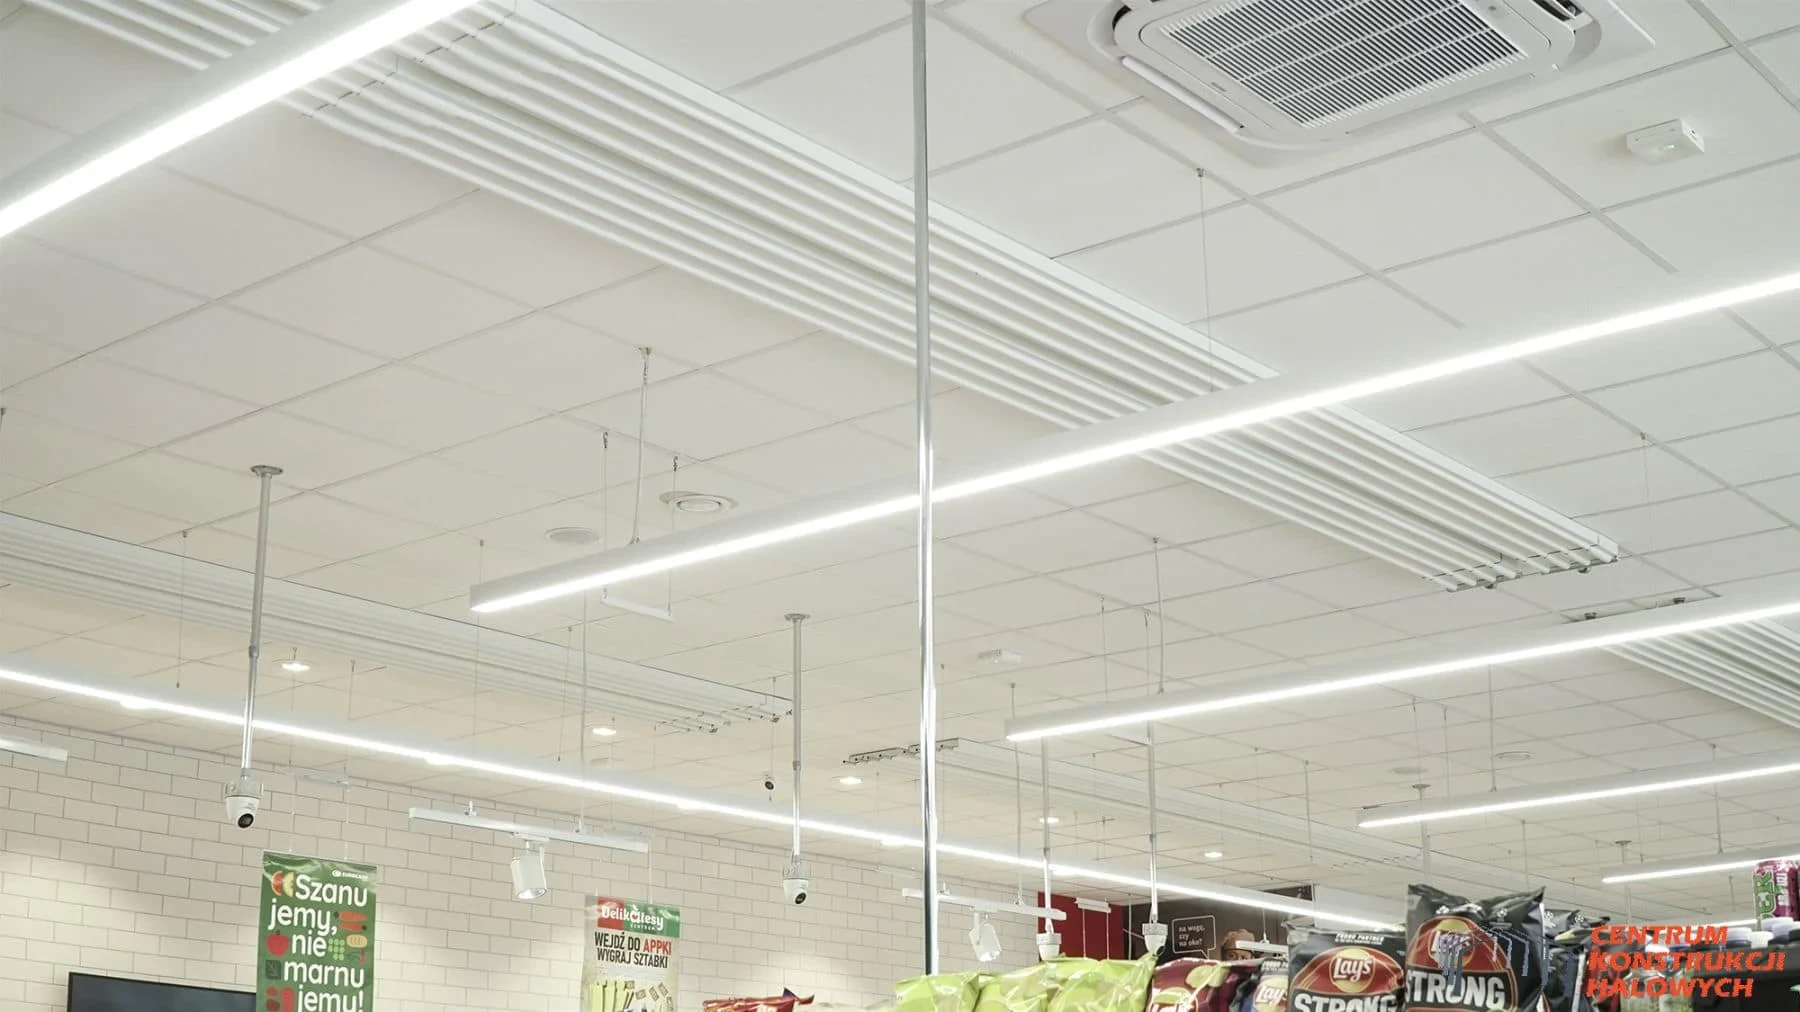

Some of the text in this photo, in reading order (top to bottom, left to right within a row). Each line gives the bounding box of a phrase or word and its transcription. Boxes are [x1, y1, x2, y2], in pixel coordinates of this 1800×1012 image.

[295, 874, 368, 907] Szanu
[267, 898, 337, 936] jemy,
[601, 904, 664, 931] Delikatesy
[291, 930, 327, 957] nie
[627, 936, 641, 951] DO
[643, 938, 672, 956] APPKI
[596, 947, 668, 969] WYGRAJ SZTABKI
[284, 961, 364, 988] marnu
